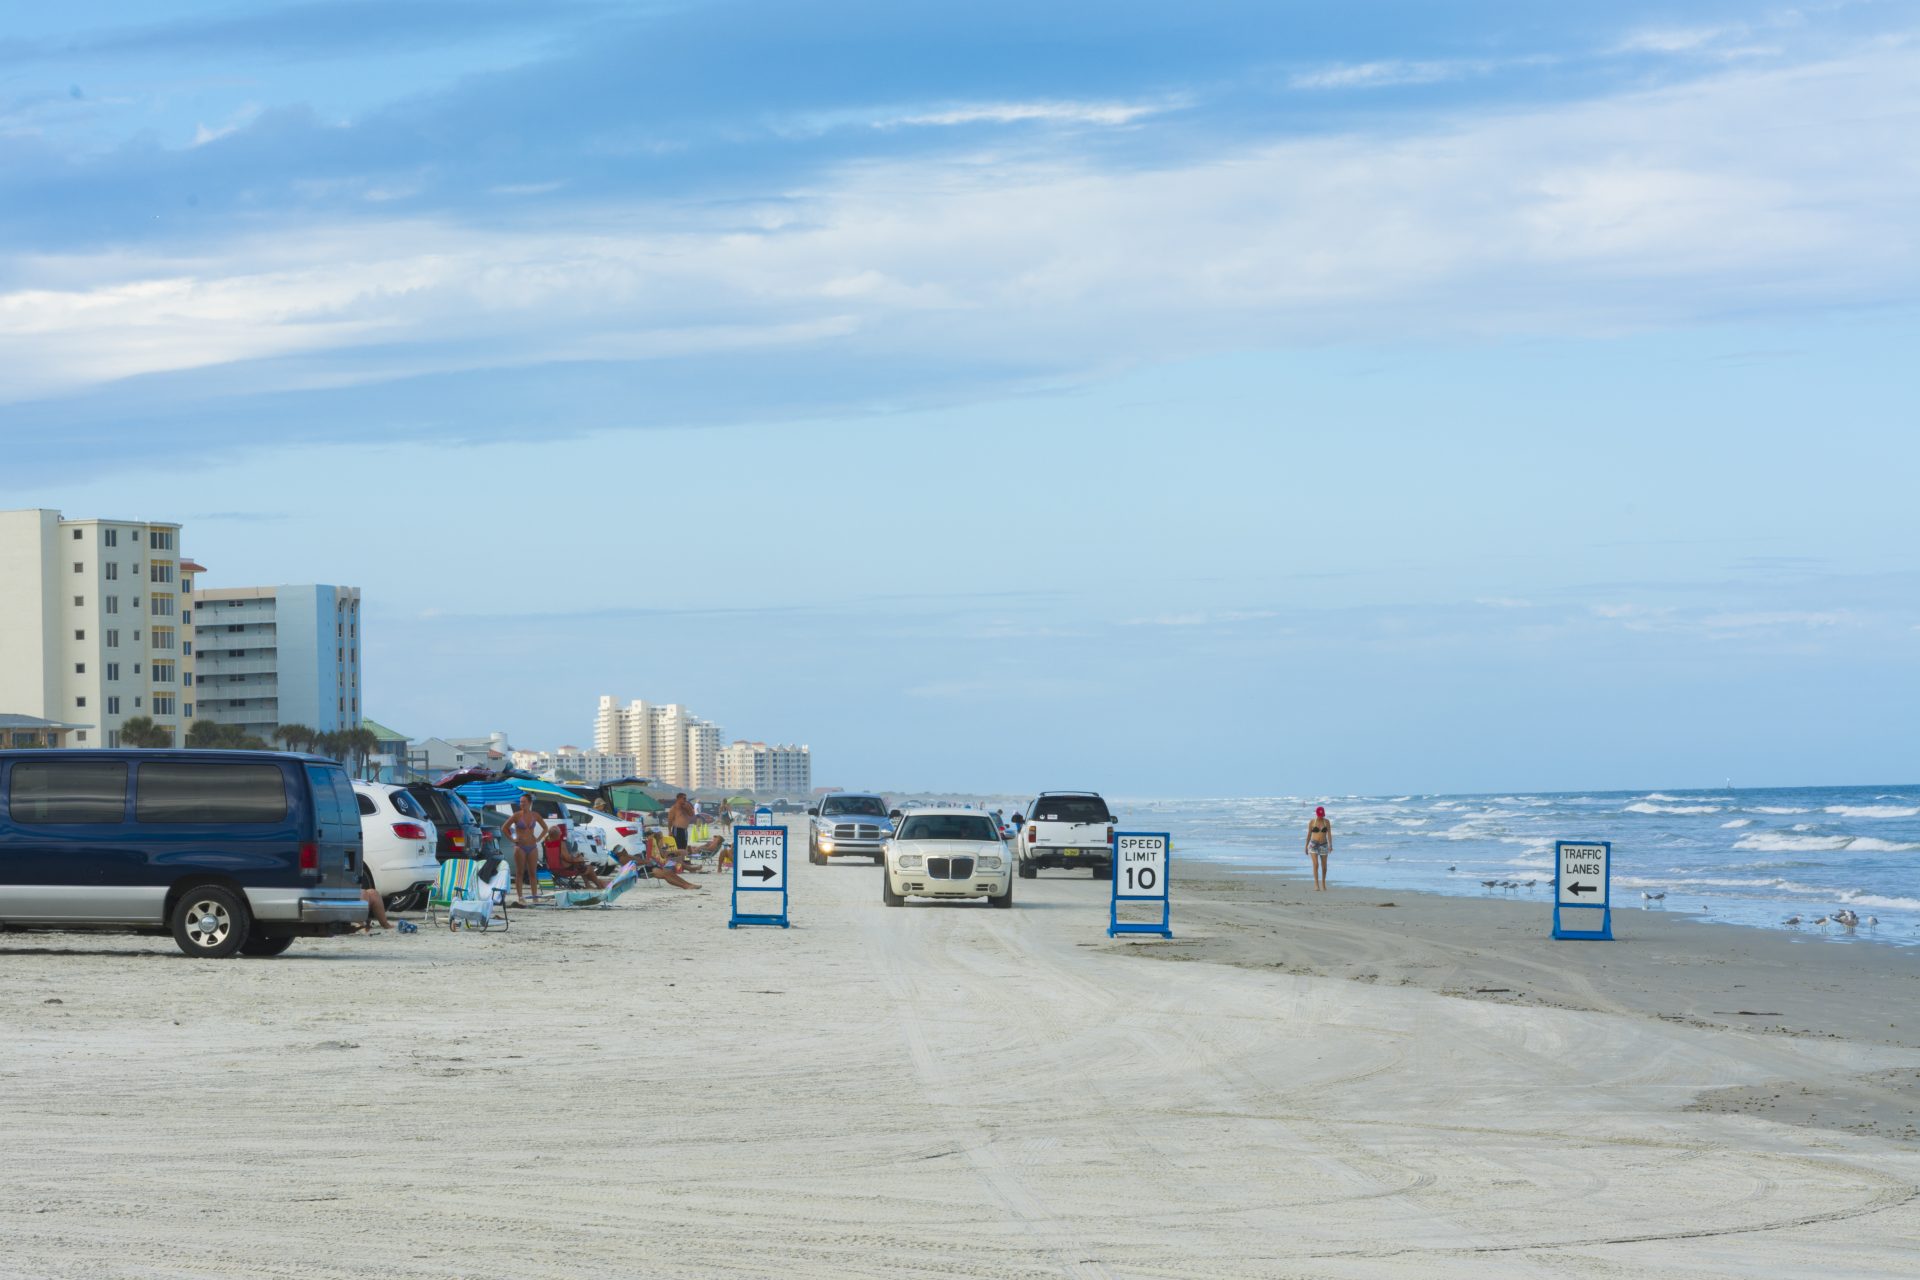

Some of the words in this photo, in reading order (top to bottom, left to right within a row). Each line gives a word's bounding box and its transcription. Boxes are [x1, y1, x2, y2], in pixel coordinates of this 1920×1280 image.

[739, 836, 782, 846] TRAFFIC
[1121, 839, 1162, 849] SPEED
[743, 850, 778, 859] LANES
[1125, 852, 1157, 862] LIMIT
[1564, 848, 1602, 860] TRAFFIC
[1566, 864, 1600, 875] LANES
[1126, 867, 1156, 890] 10
